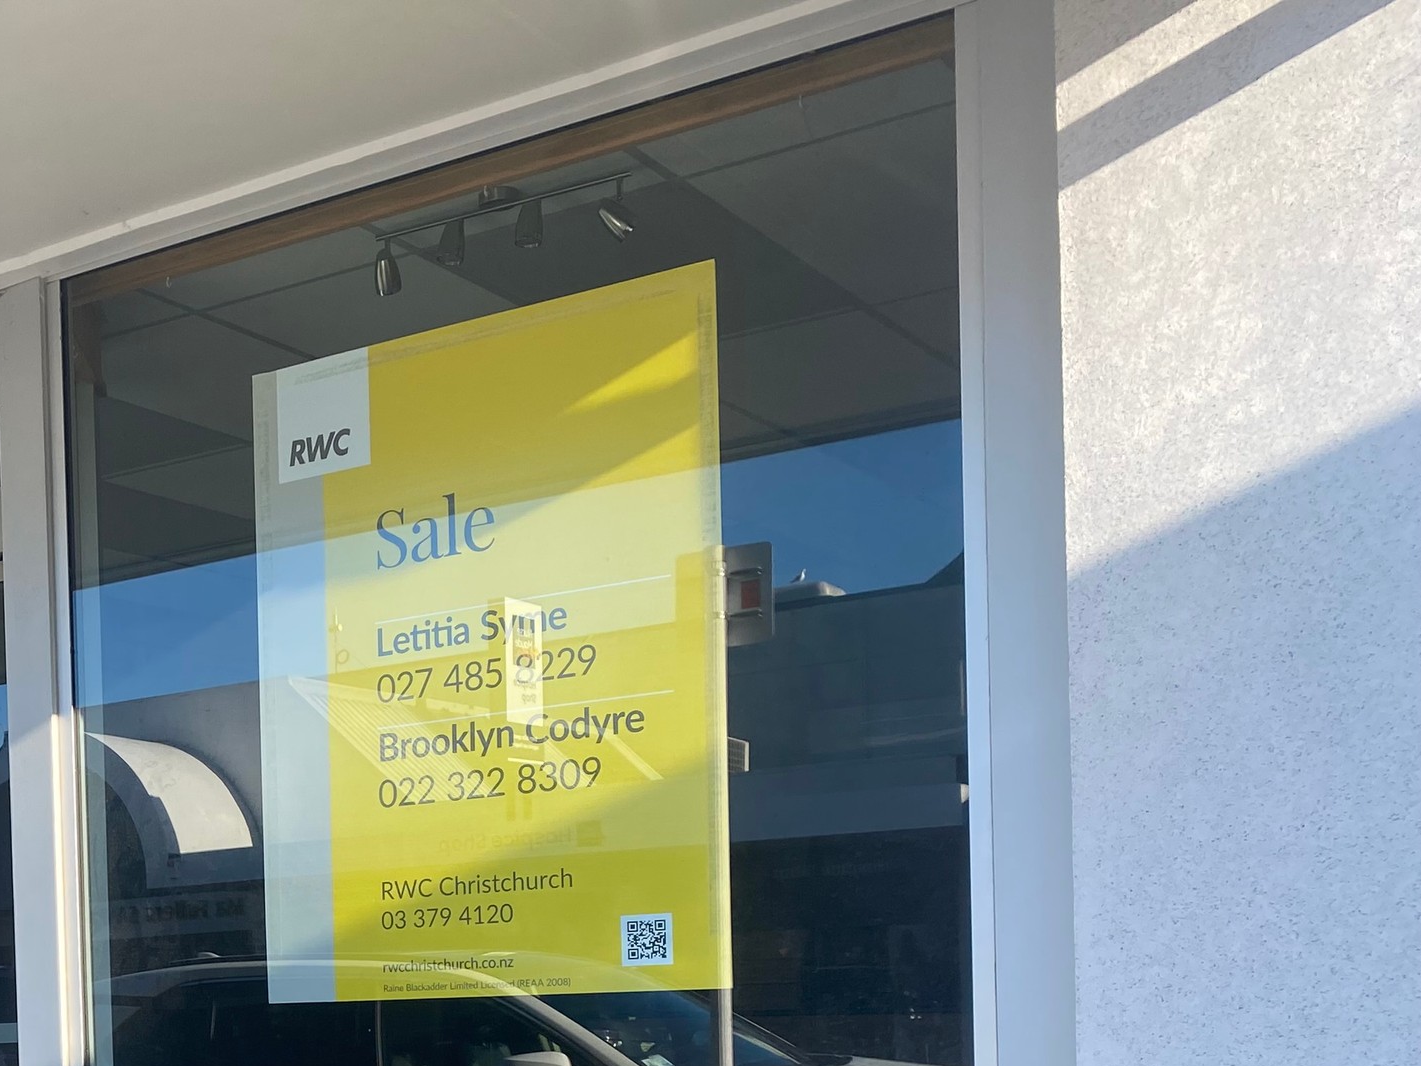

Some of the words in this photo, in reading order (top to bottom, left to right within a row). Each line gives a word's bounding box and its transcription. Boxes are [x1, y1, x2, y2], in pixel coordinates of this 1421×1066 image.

[289, 428, 351, 467] RWC
[376, 492, 495, 570] Sale
[376, 617, 470, 656] Letitia
[481, 607, 567, 645] Syme
[377, 668, 433, 703] 027
[443, 658, 502, 693] 485
[516, 645, 597, 684] 8229
[379, 722, 514, 762] Brooklyn
[526, 707, 646, 745] Codyre
[379, 774, 435, 808] 022
[447, 767, 506, 801] 322
[518, 756, 602, 794] 8309
[381, 877, 434, 901] RWC
[439, 867, 573, 897] Christchurch
[381, 910, 407, 930] 03
[413, 907, 452, 929] 379
[458, 903, 514, 926] 4120
[382, 956, 514, 974] rwcchristchurch.co.nz
[383, 984, 404, 993] Raine
[406, 982, 447, 992] Blackadder
[450, 980, 478, 991] Limited
[480, 980, 516, 990] Licensed
[516, 978, 544, 989] (REAA
[546, 977, 571, 988] 2008)
